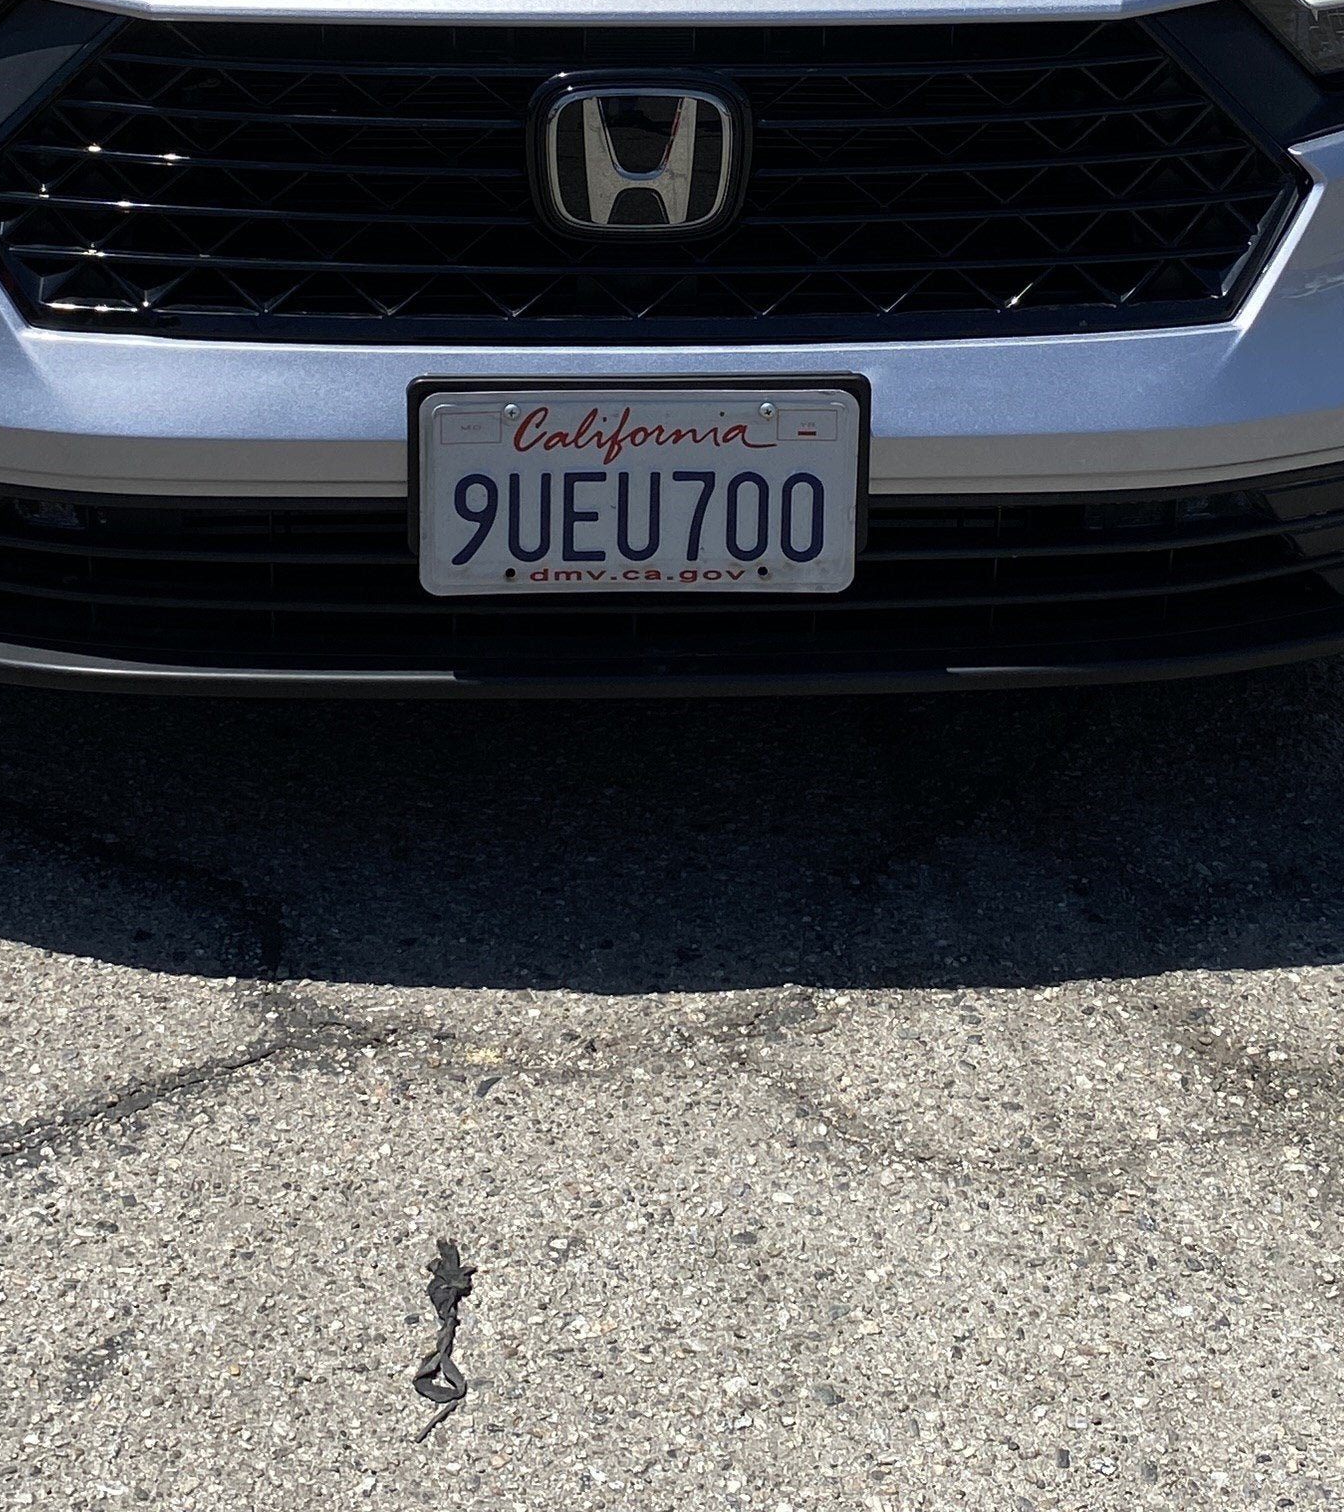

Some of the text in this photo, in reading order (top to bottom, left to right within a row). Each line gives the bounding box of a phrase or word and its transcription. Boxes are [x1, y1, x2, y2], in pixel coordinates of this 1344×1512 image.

[513, 407, 777, 465] California
[451, 471, 825, 566] 9UEU700
[529, 568, 746, 583] dmv.ca.gov
